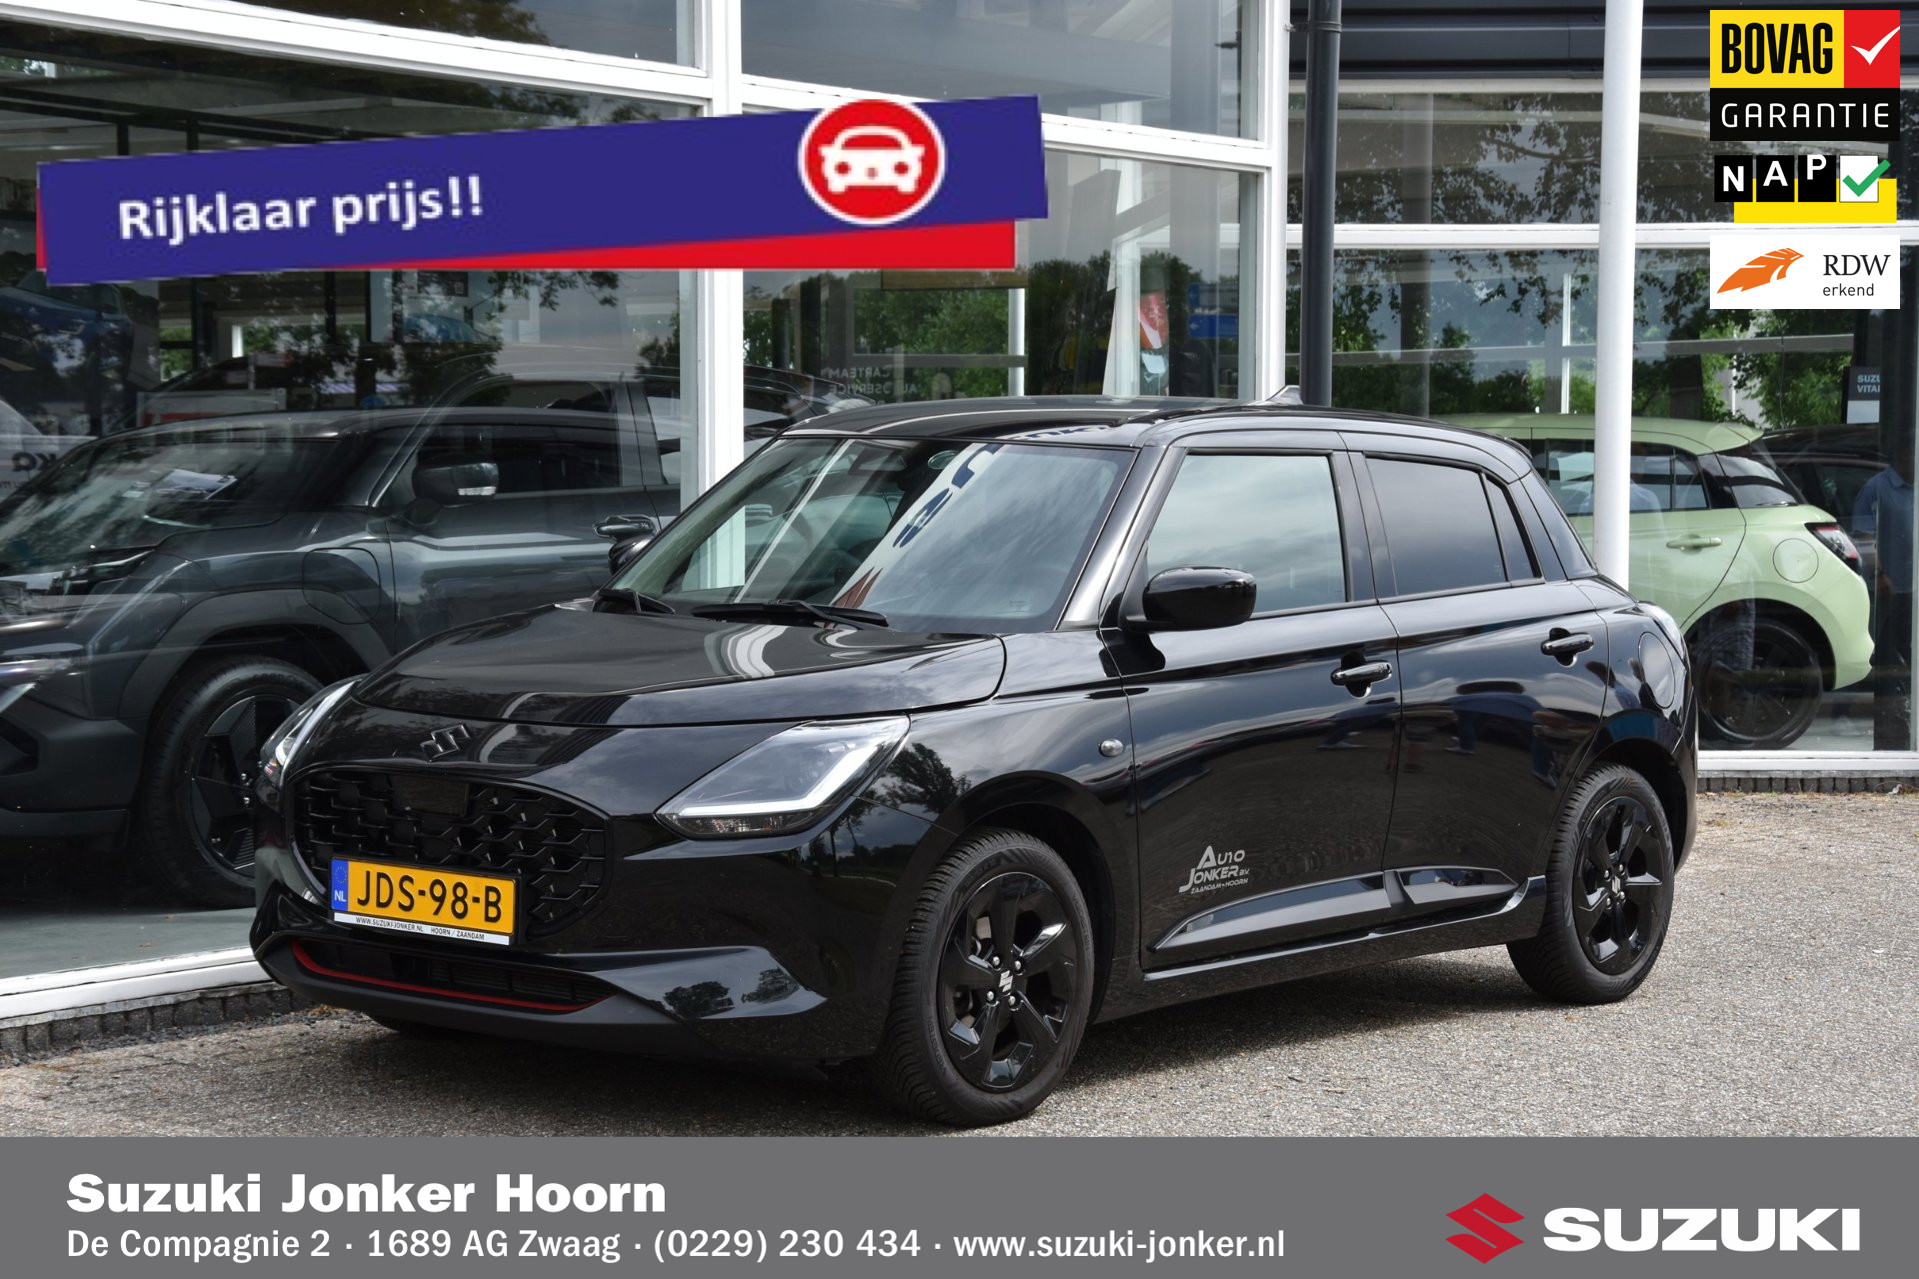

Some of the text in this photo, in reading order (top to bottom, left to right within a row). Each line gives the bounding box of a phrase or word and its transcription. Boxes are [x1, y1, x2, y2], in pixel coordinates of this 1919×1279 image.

[1178, 865, 1239, 893] JONKER
[334, 890, 347, 903] NL
[357, 870, 502, 923] JDS-98-B
[430, 926, 451, 937] HOORN
[456, 930, 485, 941] ZAANDAM
